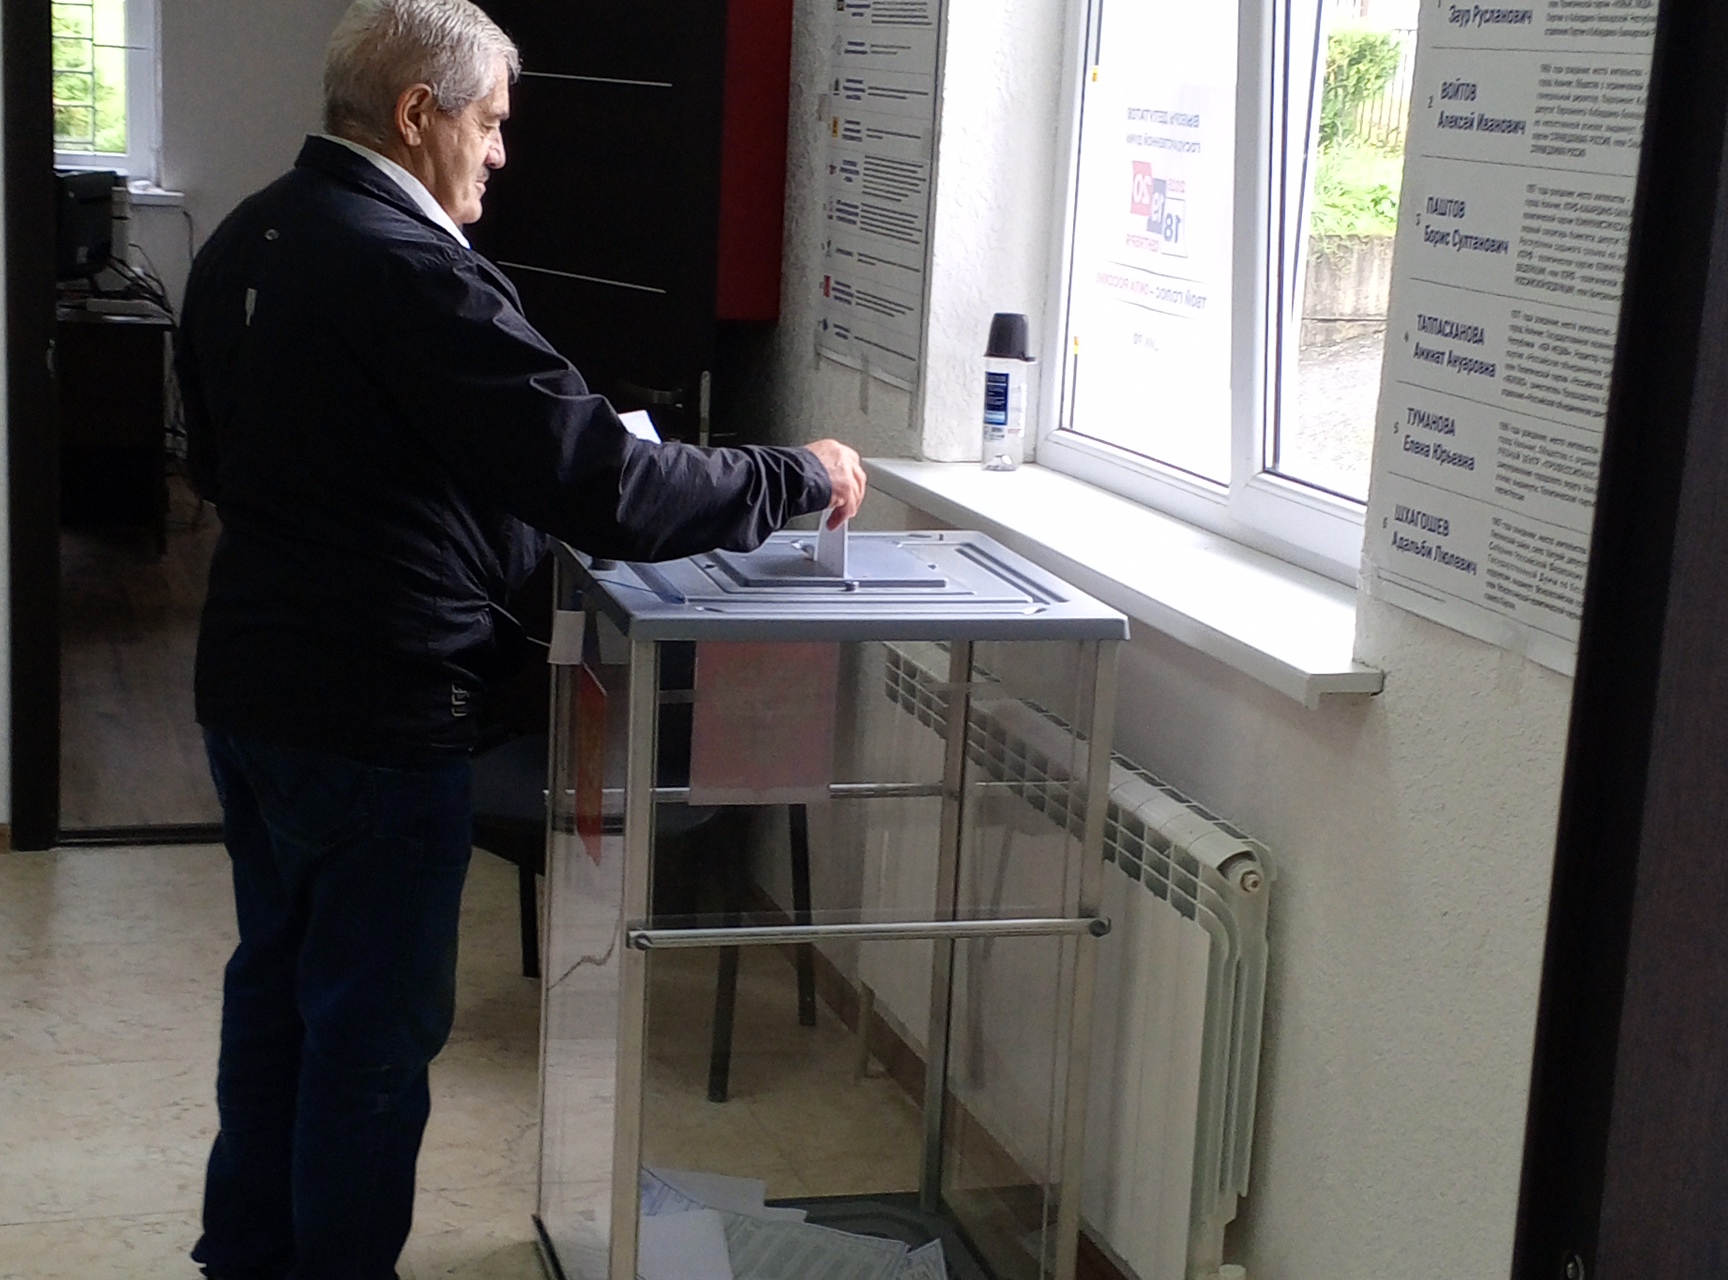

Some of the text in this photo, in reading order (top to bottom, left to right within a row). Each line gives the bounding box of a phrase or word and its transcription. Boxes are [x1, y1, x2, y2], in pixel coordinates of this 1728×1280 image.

[1449, 4, 1533, 28] Заур Русланович
[1441, 78, 1477, 101] ВОЙТОВ
[1438, 111, 1526, 135] Алексей Иванович
[1426, 196, 1465, 218] ПАШТОВ
[1424, 224, 1509, 255] Борис Султанович
[1417, 314, 1484, 346] ТАППАСХАНОВА
[1413, 341, 1496, 378] Аминат Ануаровна
[1407, 407, 1455, 437] ТУМАНОВА
[1403, 434, 1475, 471] Елена Юрьевна
[1395, 504, 1449, 537] ШХАГОШЕВ
[1391, 530, 1478, 576] Адальби Люлевич
